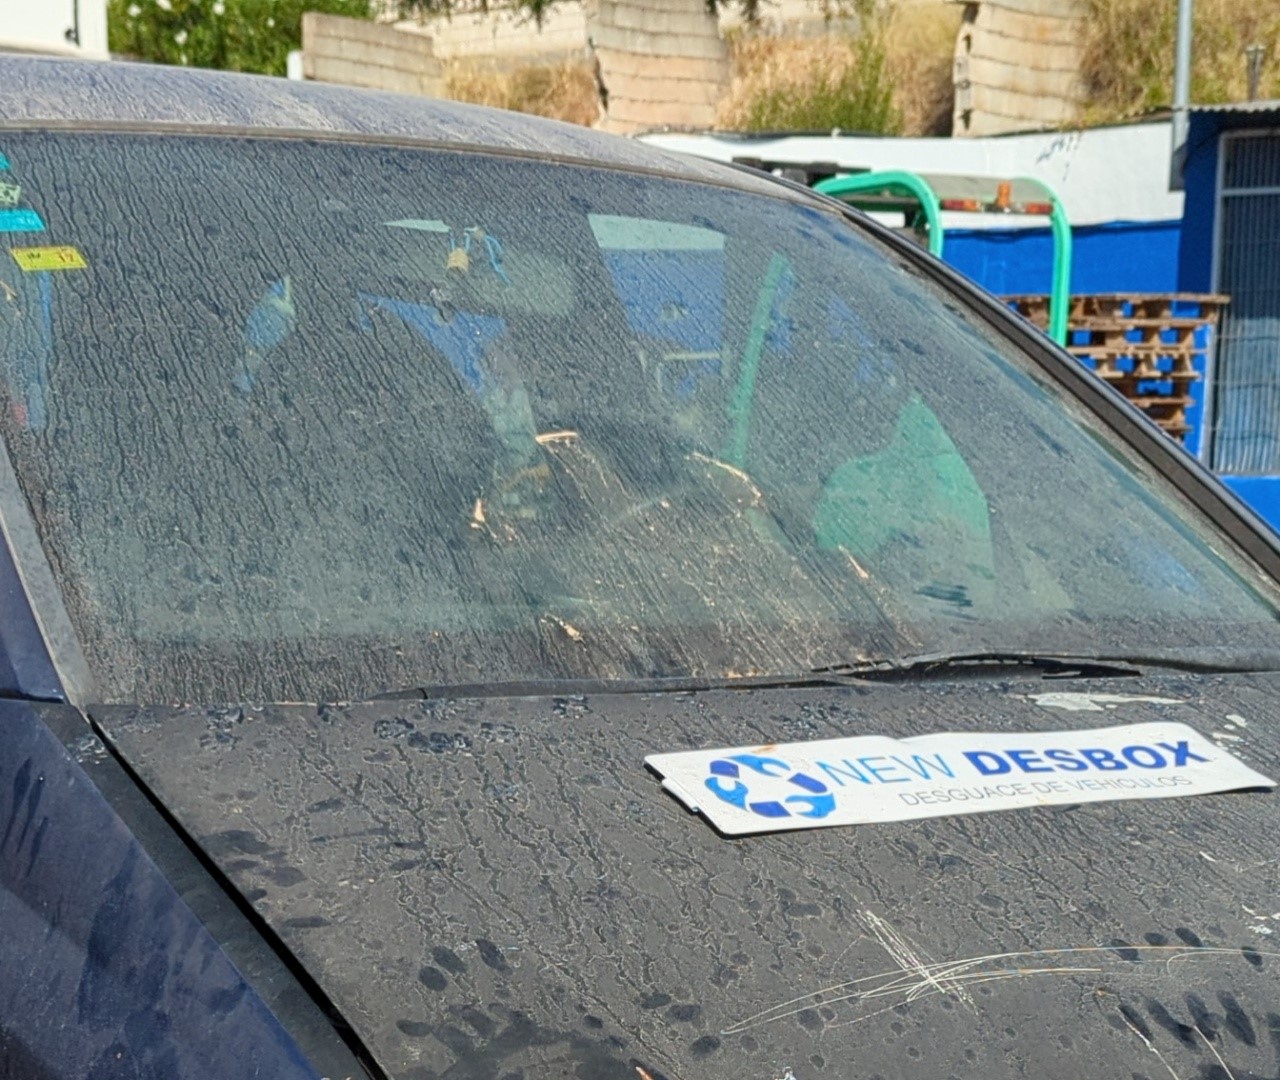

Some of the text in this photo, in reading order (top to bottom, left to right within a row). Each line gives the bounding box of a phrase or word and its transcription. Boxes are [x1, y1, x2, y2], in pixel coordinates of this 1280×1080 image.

[816, 741, 1210, 786] NEW DESBOX
[898, 782, 1033, 806] DESGUACE
[1031, 780, 1068, 794] DE
